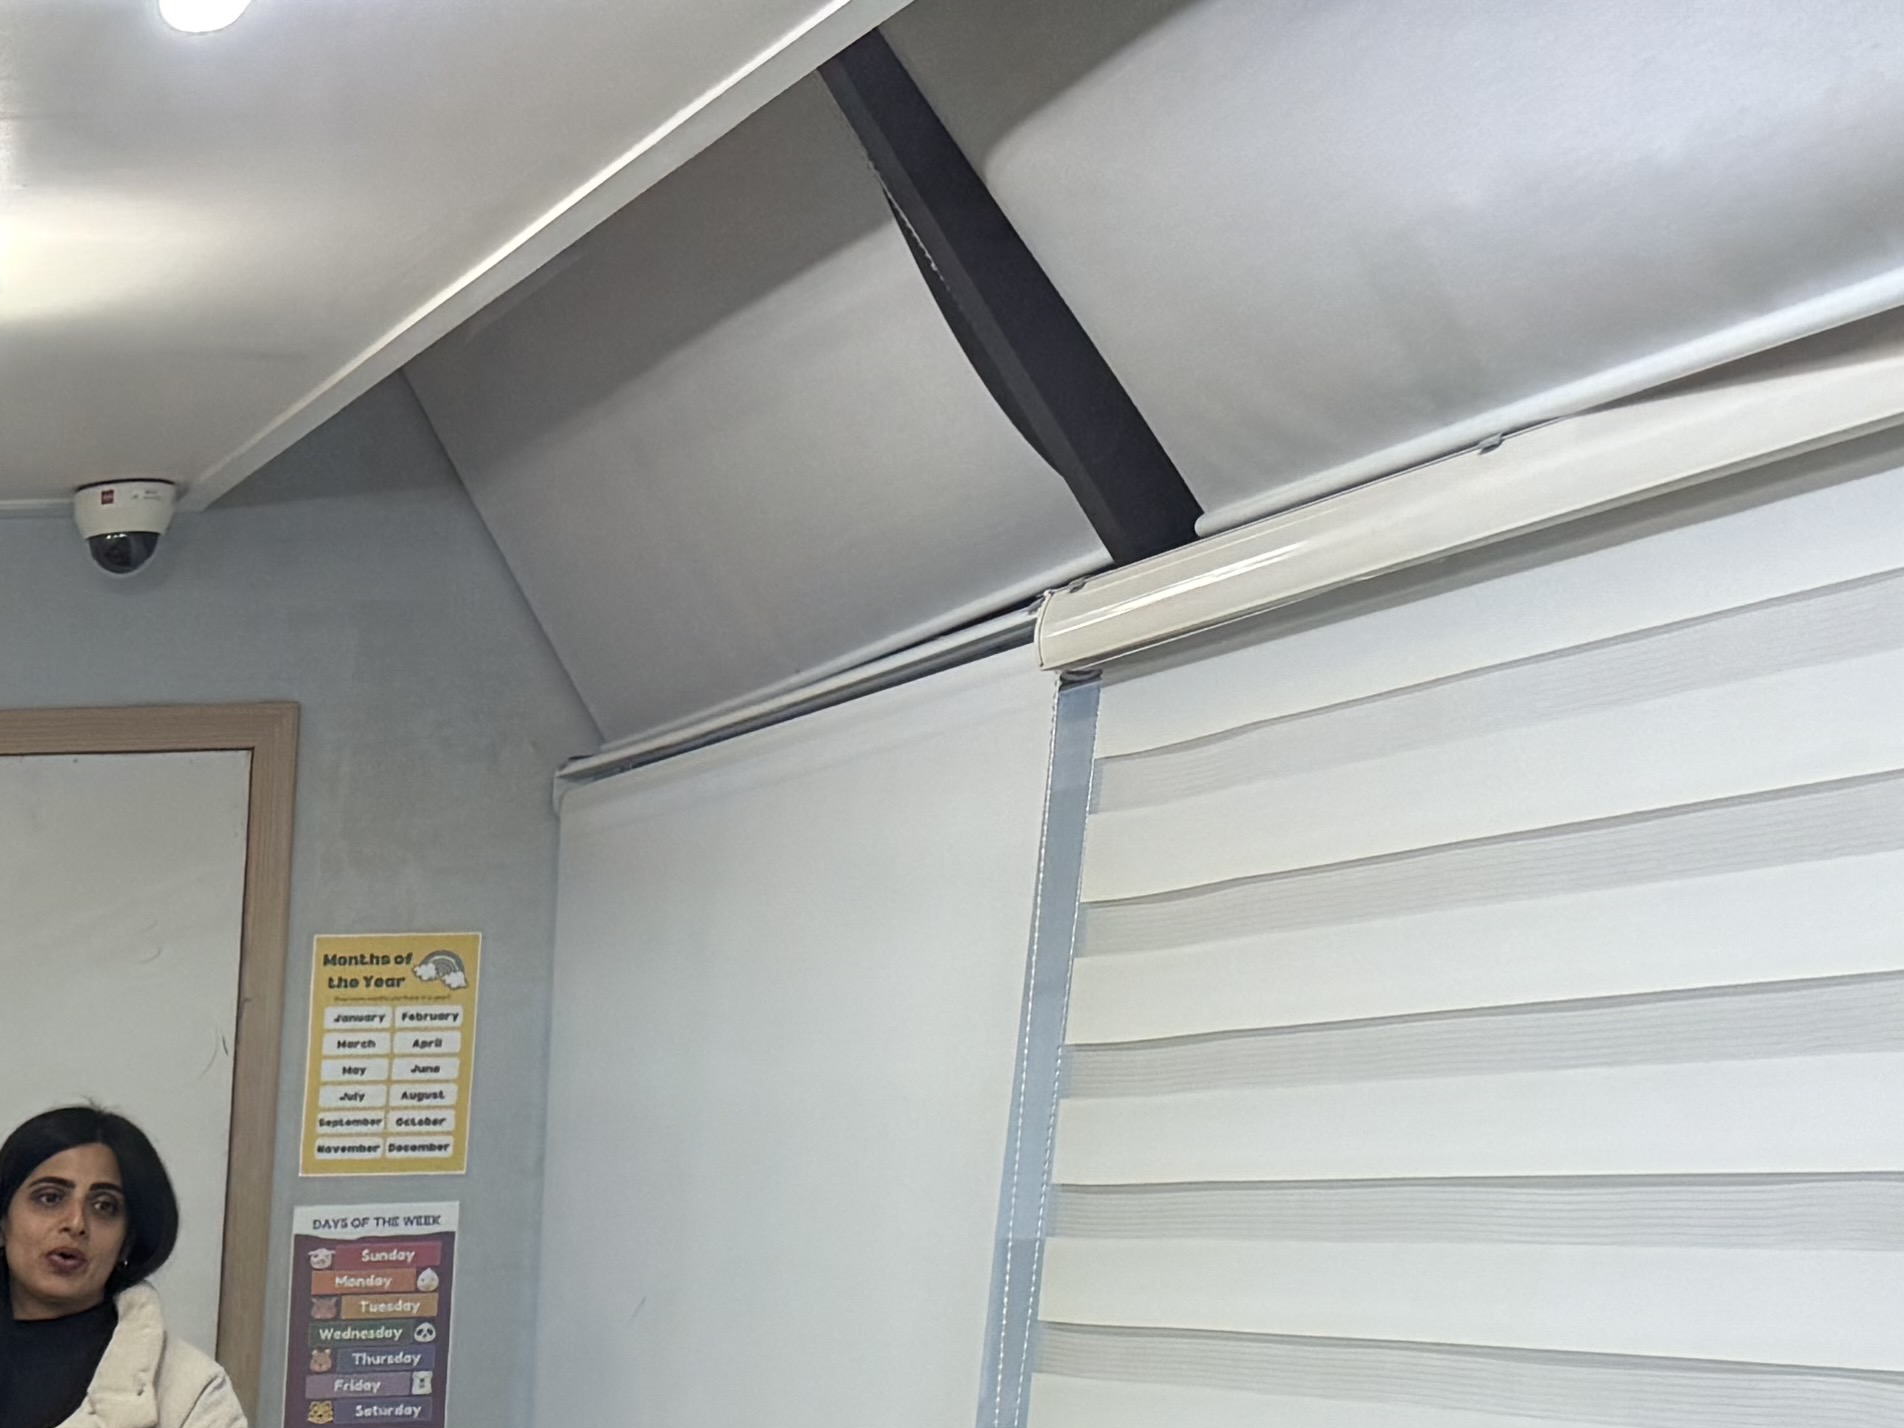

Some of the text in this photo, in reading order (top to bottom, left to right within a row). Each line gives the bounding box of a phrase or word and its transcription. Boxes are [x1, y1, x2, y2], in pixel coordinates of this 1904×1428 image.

[324, 953, 413, 966] Months of
[328, 976, 406, 989] the Year
[334, 1012, 458, 1024] January February
[338, 1038, 442, 1049] March April
[342, 1065, 440, 1076] May June
[340, 1091, 444, 1102] July August
[319, 1117, 446, 1128] September October
[317, 1142, 450, 1154] November December
[313, 1216, 440, 1230] DAYS OF THE WEEK
[362, 1250, 415, 1262] Sunday
[336, 1276, 392, 1288] Monday
[360, 1302, 420, 1314] Tuesday
[320, 1327, 402, 1340] Wednesday
[352, 1353, 421, 1365] Thursday
[334, 1379, 380, 1393] Friday
[355, 1405, 421, 1418] Saturday
